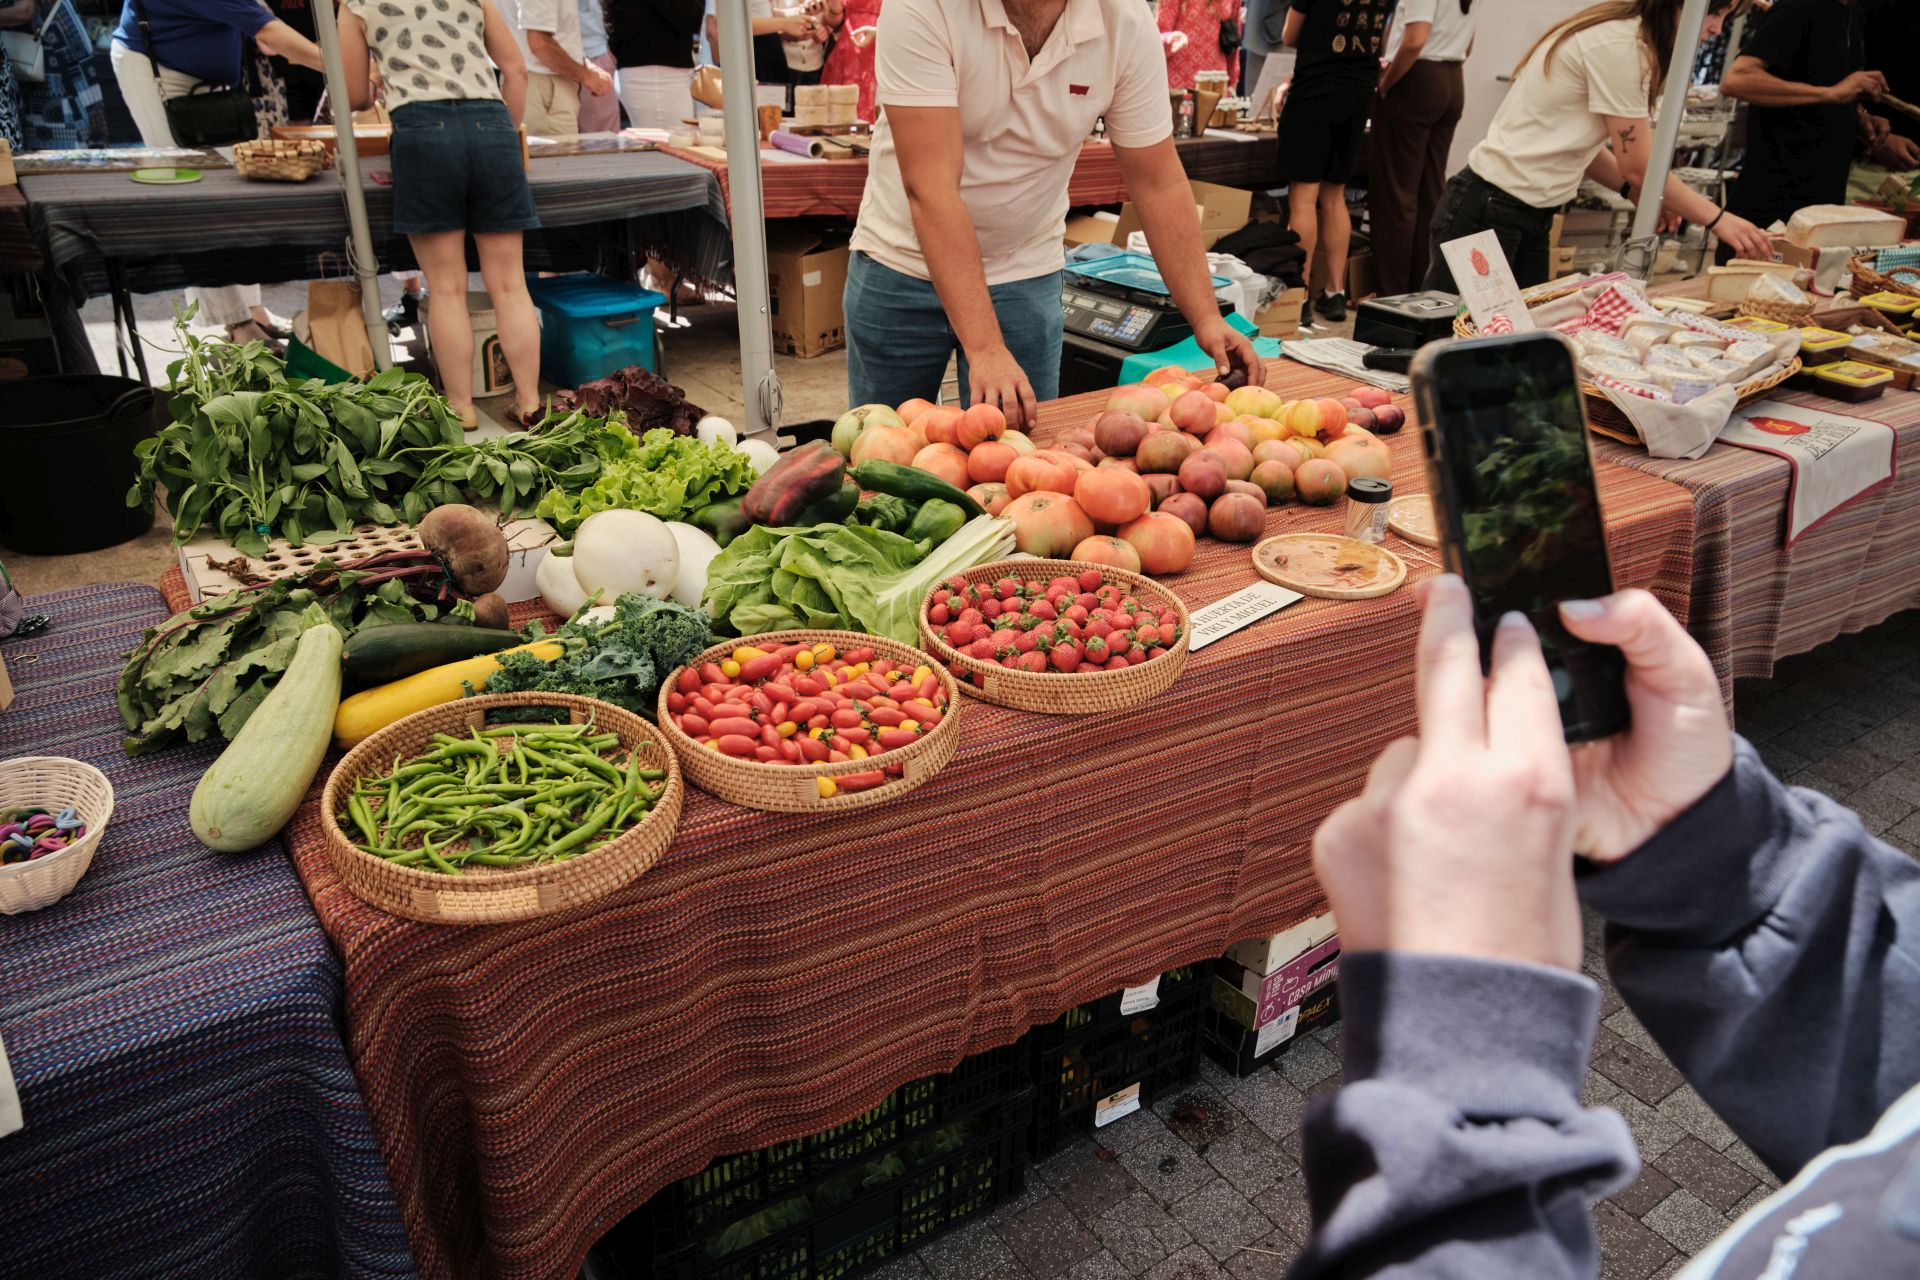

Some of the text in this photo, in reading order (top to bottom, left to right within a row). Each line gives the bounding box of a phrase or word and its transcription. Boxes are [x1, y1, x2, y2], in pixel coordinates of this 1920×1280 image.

[1804, 443, 1826, 457] DE
[1196, 600, 1245, 624] HUERTA
[1244, 592, 1262, 603] DE
[1197, 623, 1223, 637] VIKI
[1230, 599, 1277, 622] MIGUEL
